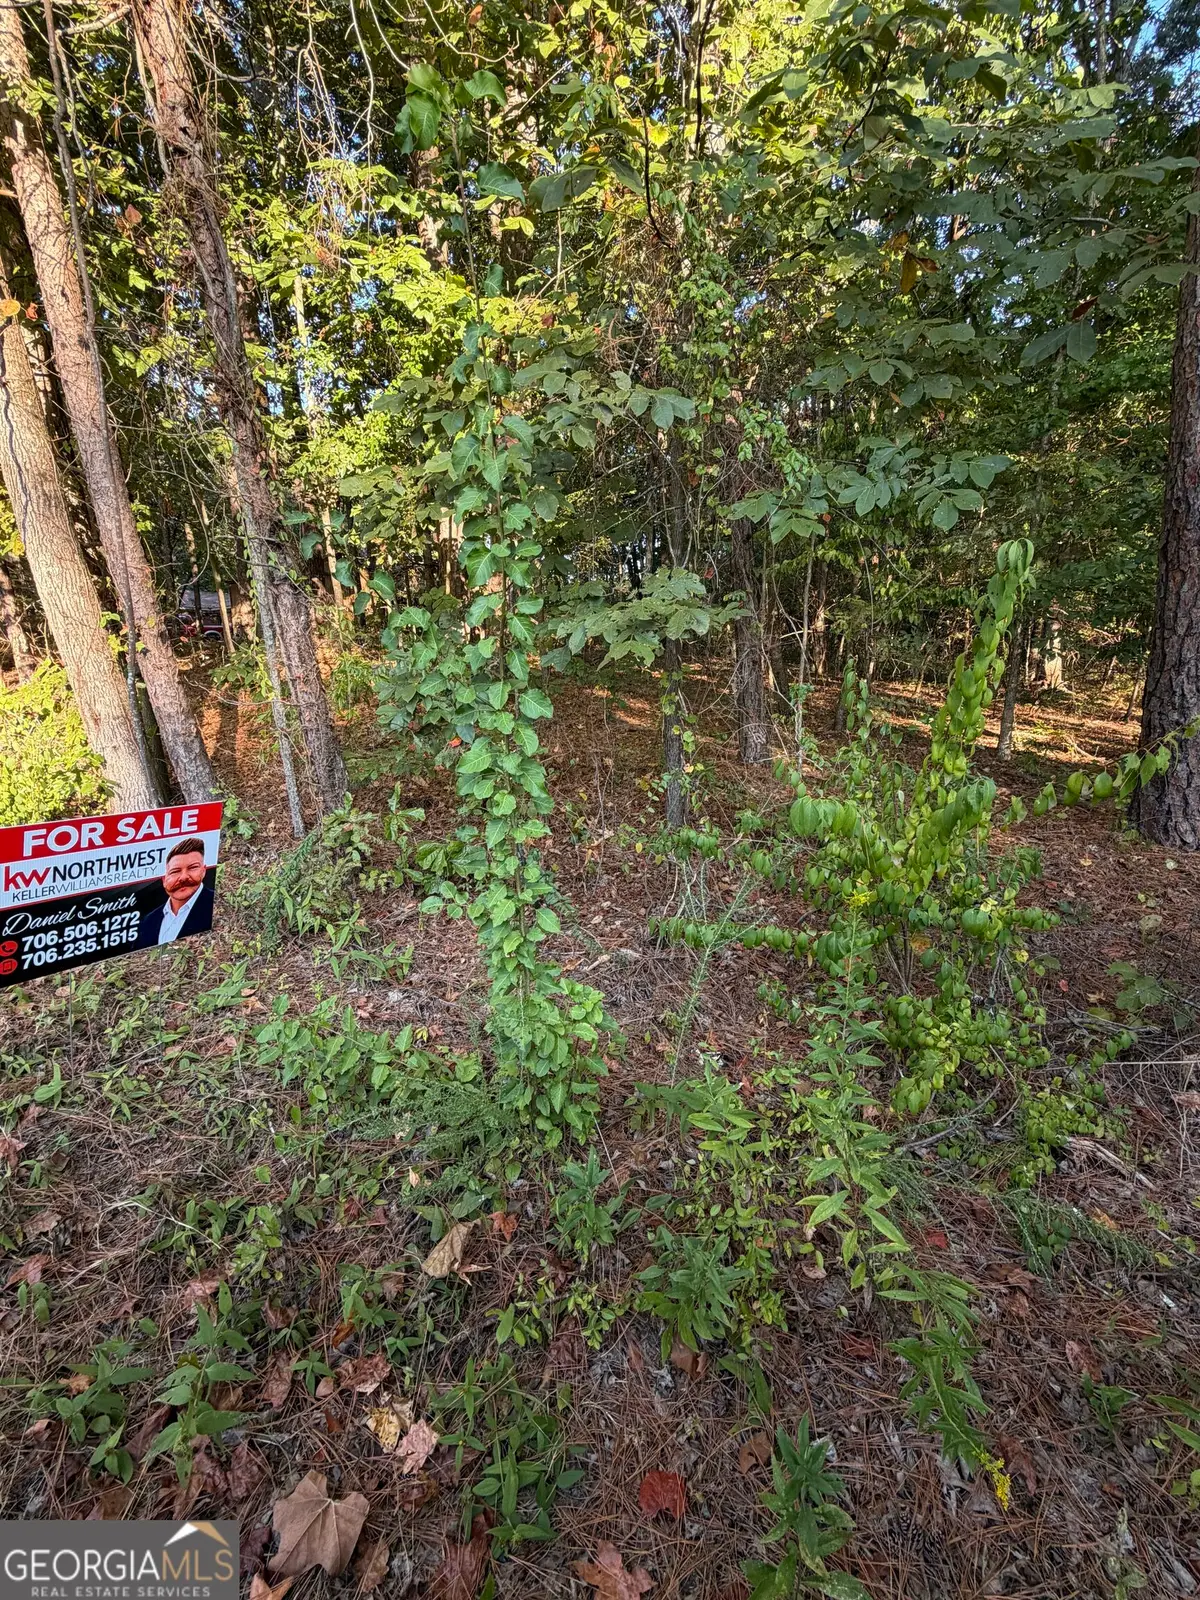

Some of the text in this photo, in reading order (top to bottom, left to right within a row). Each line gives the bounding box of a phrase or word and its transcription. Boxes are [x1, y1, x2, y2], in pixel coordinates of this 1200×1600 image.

[23, 809, 199, 857] FOR SALE
[52, 847, 166, 883] NORTHWEST
[2, 893, 137, 936] Daniel Smith
[22, 911, 140, 952] 706.506.1272
[22, 928, 138, 970] 706.235.1515
